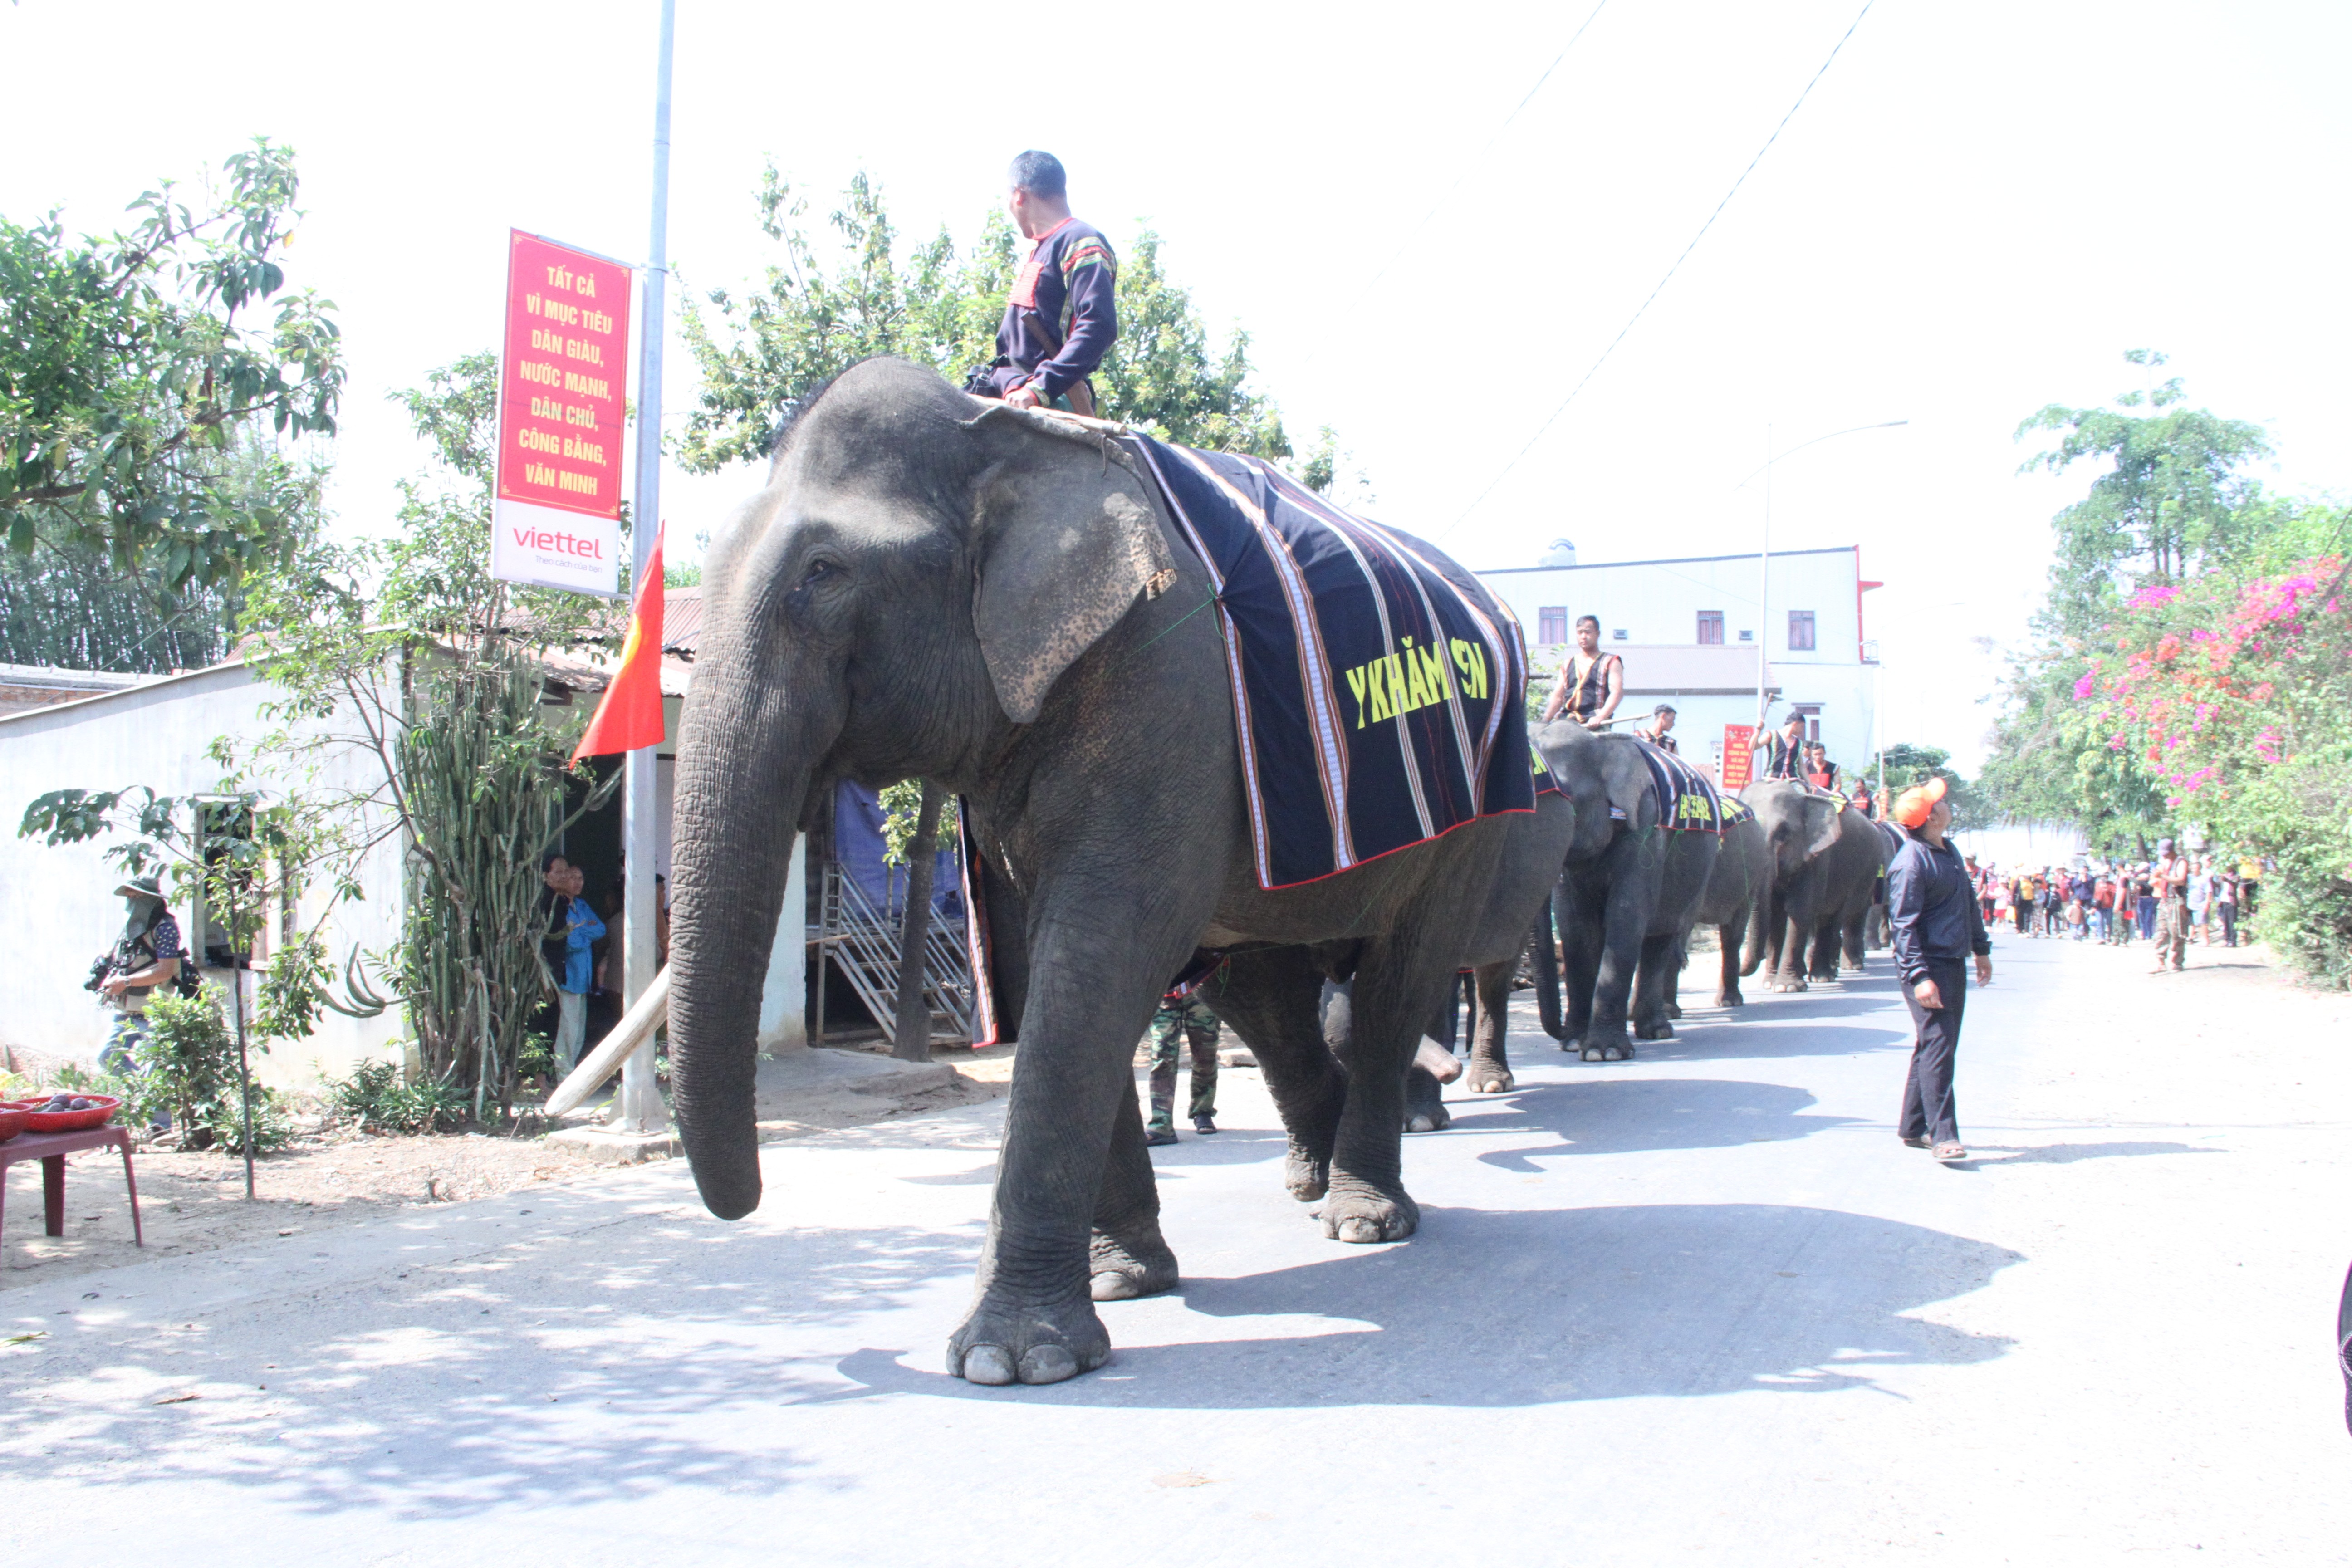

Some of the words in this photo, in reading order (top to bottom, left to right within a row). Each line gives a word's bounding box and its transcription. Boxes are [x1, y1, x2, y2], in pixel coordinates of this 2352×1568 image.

[547, 265, 573, 290] TẤT
[576, 273, 595, 298] CẢ
[526, 293, 540, 315] VÌ
[545, 299, 578, 326] MỤC
[582, 310, 612, 334] TIÊU
[532, 329, 563, 354] DÂN
[567, 339, 603, 368] GIÀU,
[520, 360, 561, 387] NƯỚC
[565, 372, 612, 402] MẠNH,
[531, 396, 562, 421] DÂN
[566, 405, 598, 432] CHỦ,
[519, 427, 559, 454] CÔNG
[564, 434, 607, 466] BẰNG,
[525, 462, 555, 487] VĂN
[559, 471, 598, 495] MINH
[513, 526, 603, 559] viettel
[536, 555, 554, 565] Theo
[555, 559, 573, 568] cách
[574, 562, 587, 570] của
[589, 565, 603, 573] bạn
[1346, 636, 1452, 729] YKHĂM
